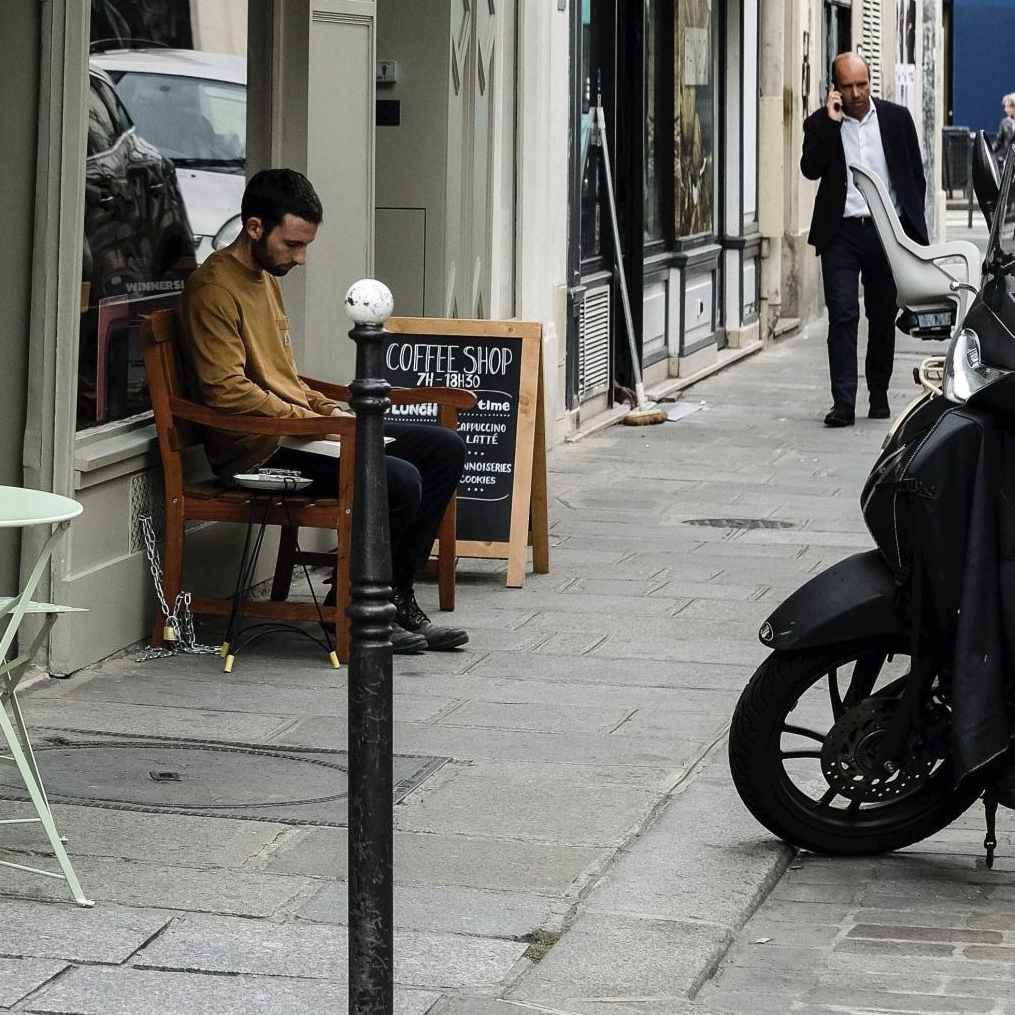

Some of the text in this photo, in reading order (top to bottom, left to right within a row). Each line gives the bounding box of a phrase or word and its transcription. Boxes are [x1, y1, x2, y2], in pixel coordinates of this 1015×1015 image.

[126, 279, 185, 292] WINNERS!
[386, 343, 513, 375] COFFEE SHOP
[417, 373, 434, 387] 7H
[445, 373, 481, 388] 18H30
